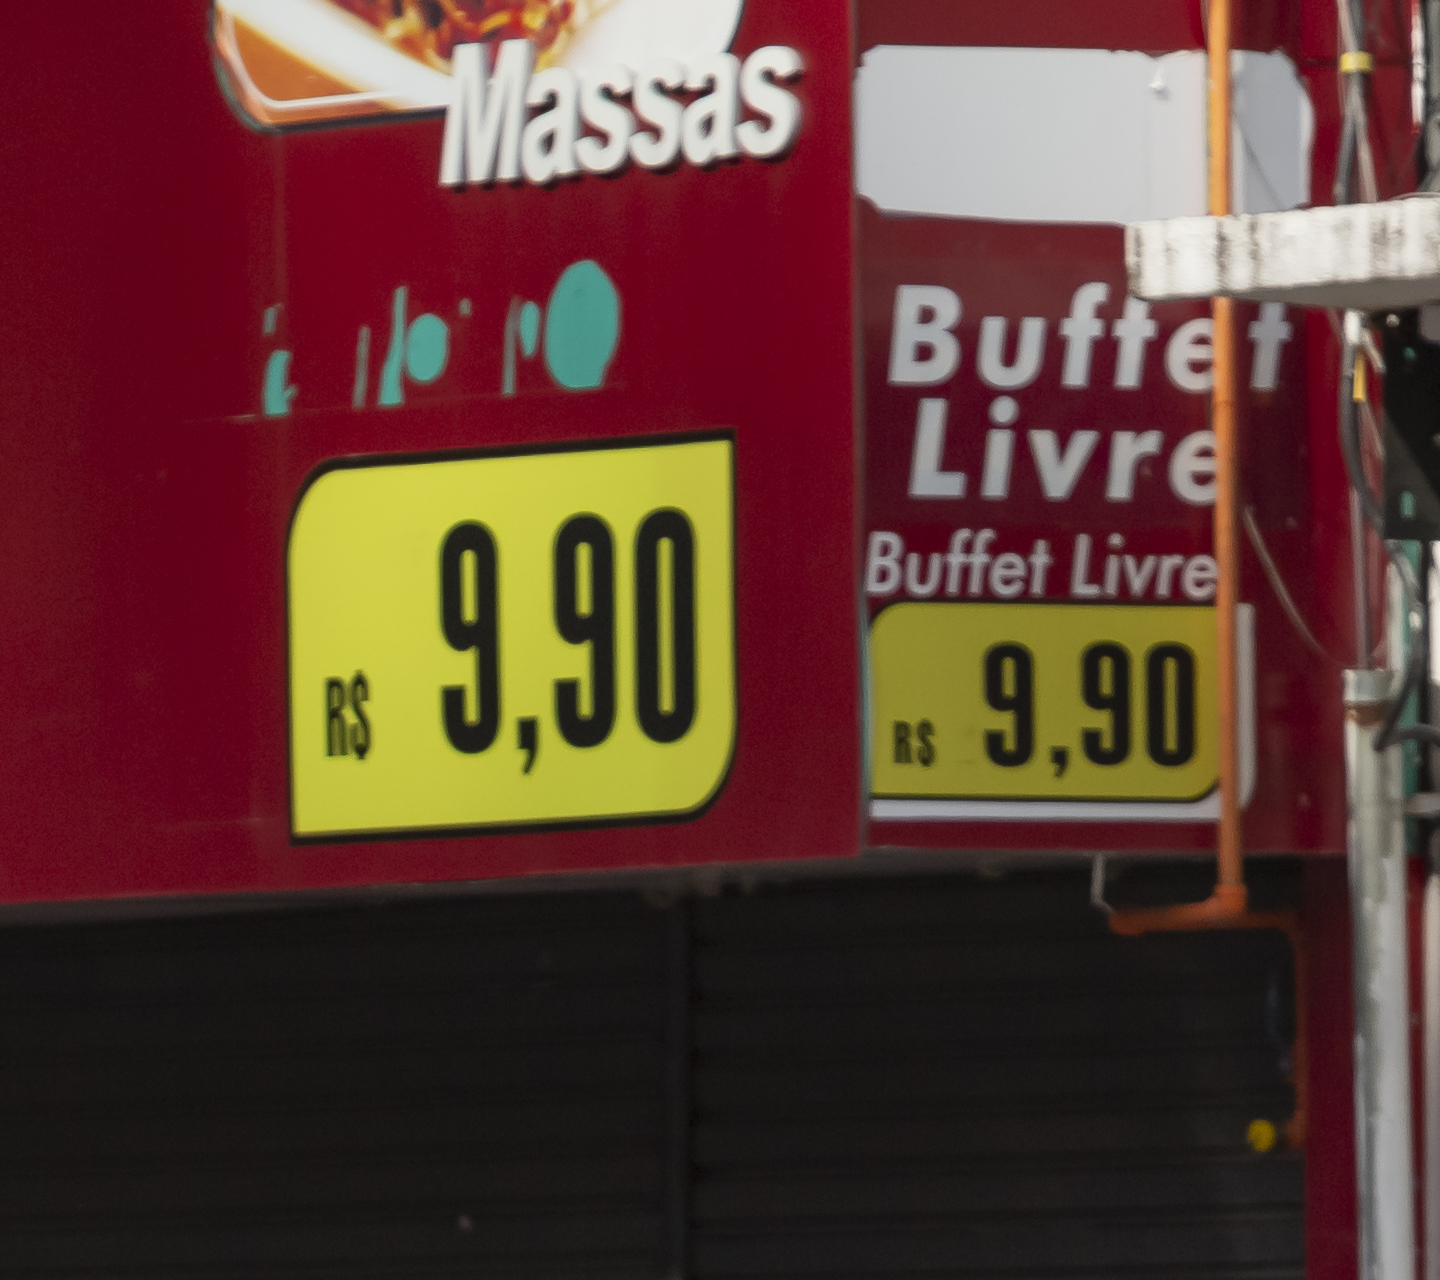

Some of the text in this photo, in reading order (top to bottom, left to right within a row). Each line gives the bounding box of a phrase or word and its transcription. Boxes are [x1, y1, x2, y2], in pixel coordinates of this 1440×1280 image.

[439, 39, 805, 188] Massas
[889, 284, 1291, 393] Buffet
[910, 398, 1219, 505] Livre
[865, 530, 1219, 599] Buffet Livre
[326, 505, 700, 777] R$ 9,90
[893, 640, 1200, 778] R$ 9,90
